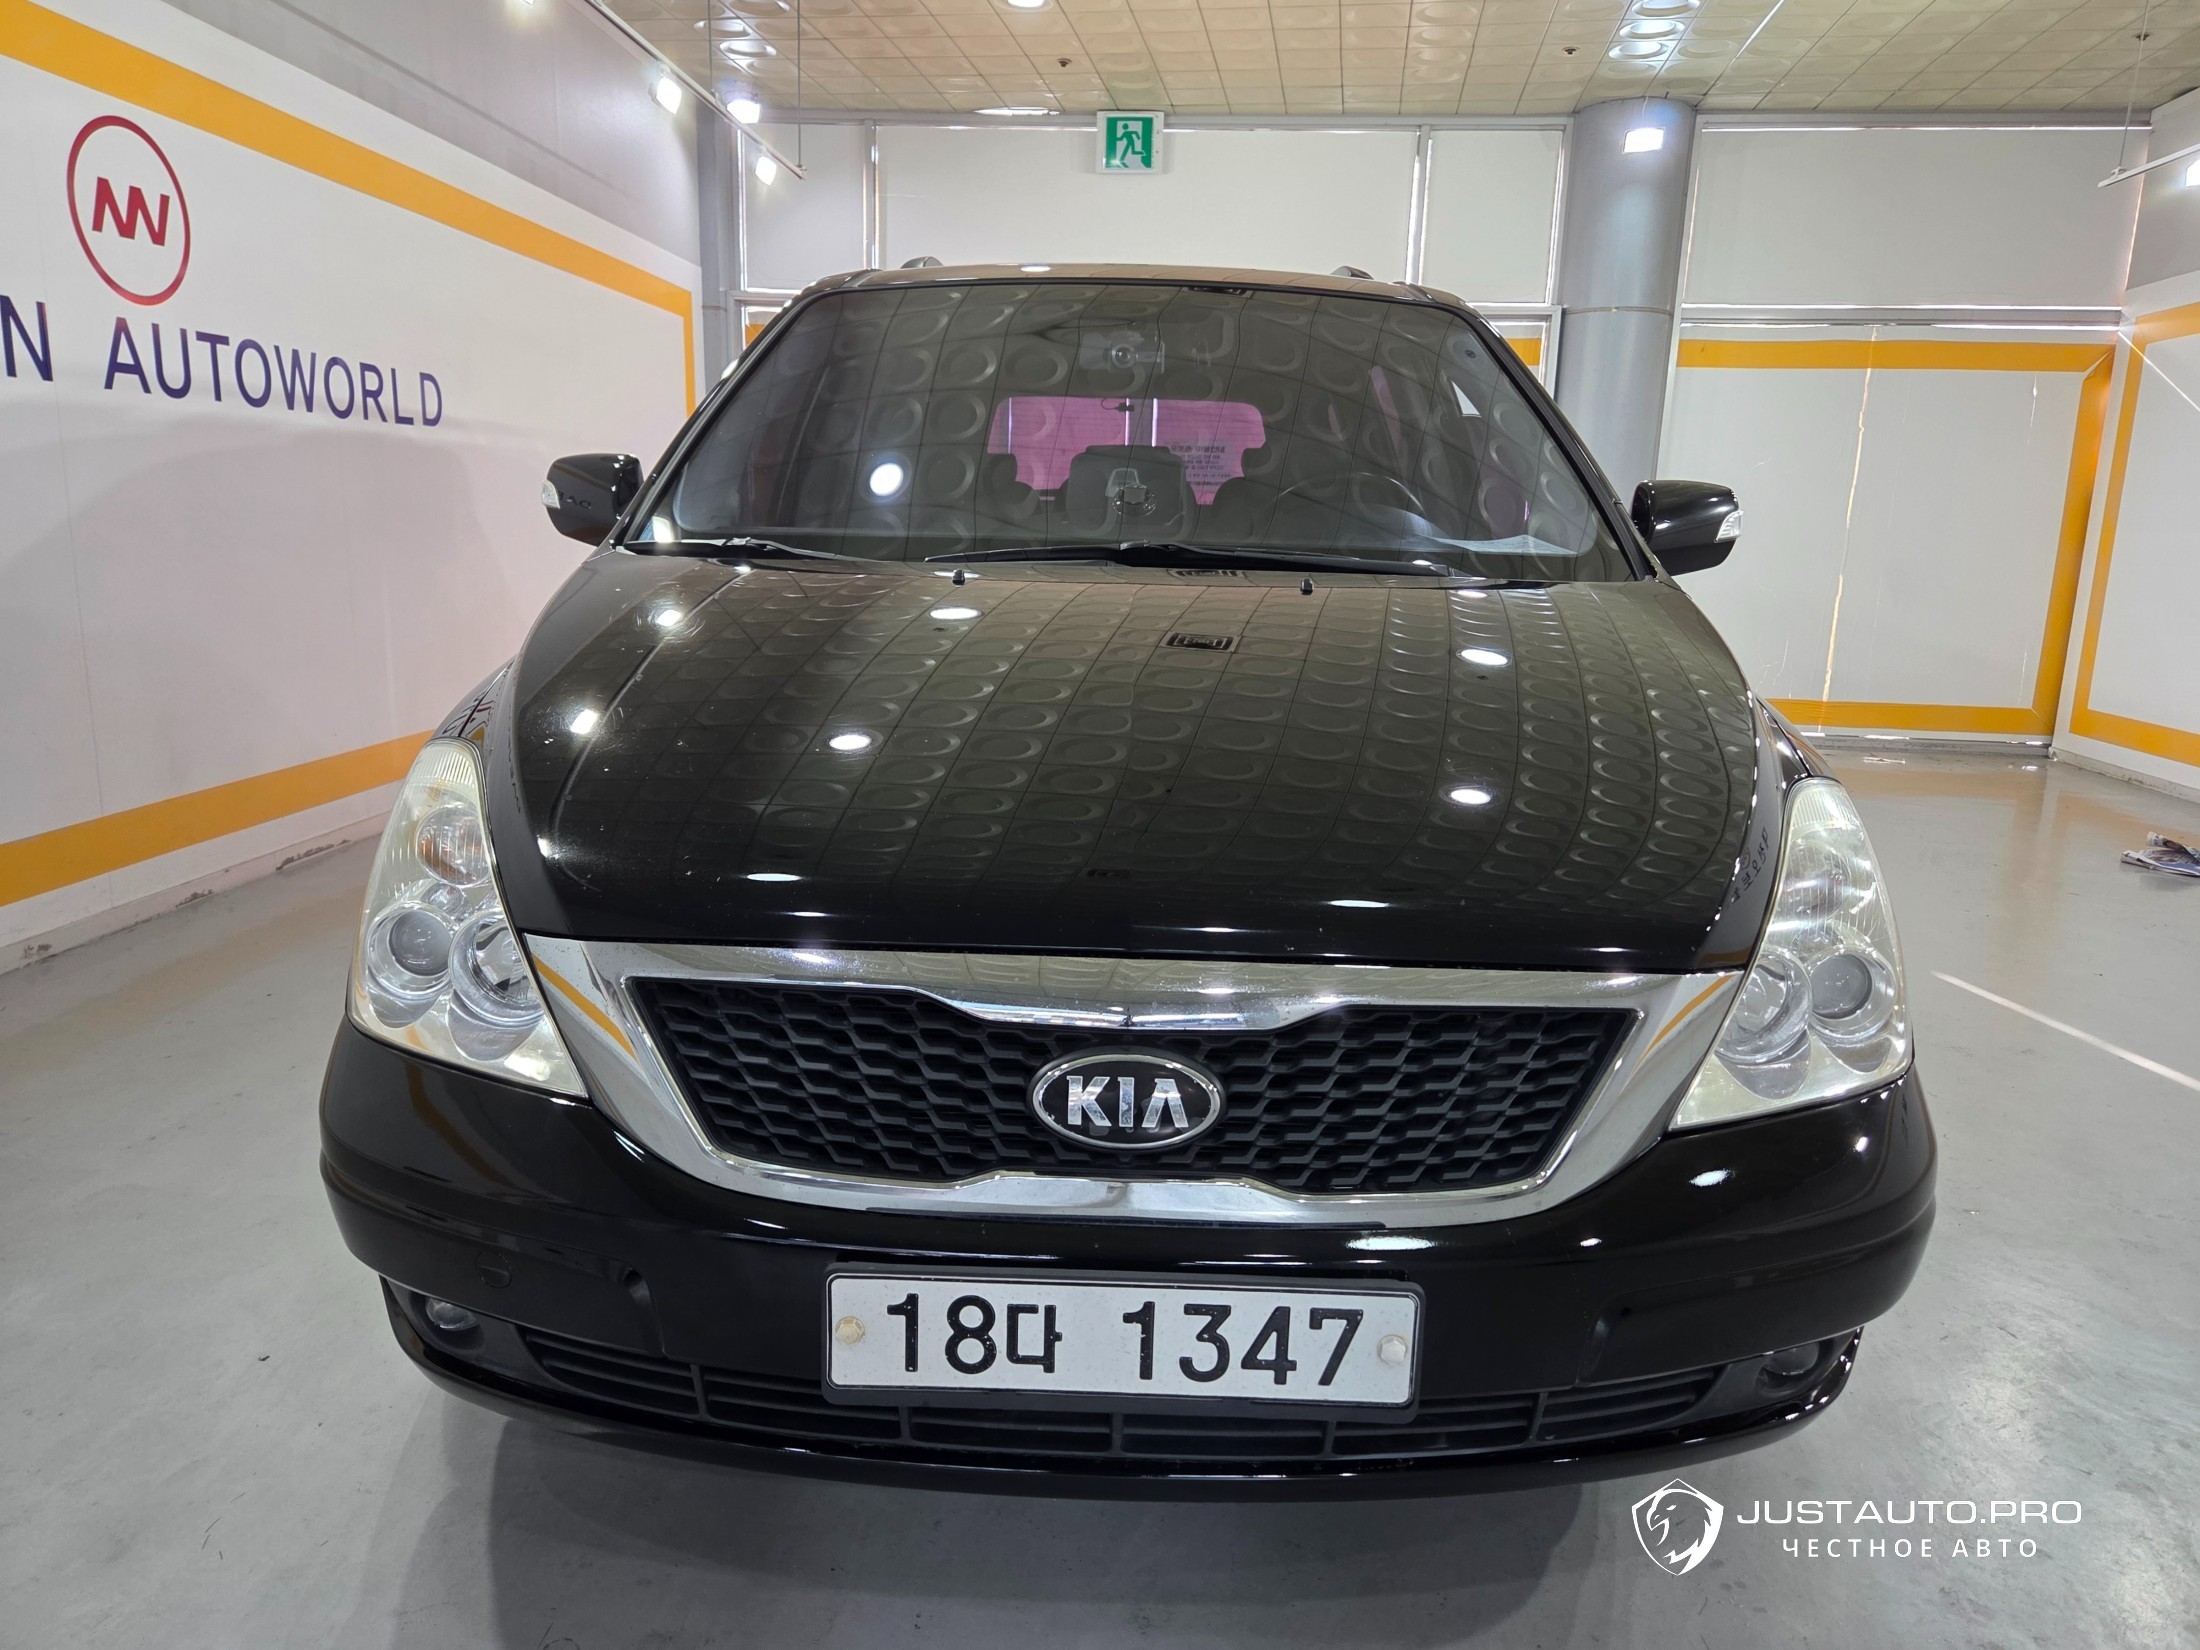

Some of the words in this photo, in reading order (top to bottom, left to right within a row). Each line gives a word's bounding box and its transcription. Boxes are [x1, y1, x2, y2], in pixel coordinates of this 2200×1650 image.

[104, 316, 443, 427] AUTOWORLD
[1066, 1075, 1189, 1128] KIA
[886, 1292, 1063, 1375] 18다
[1122, 1301, 1364, 1387] 1347
